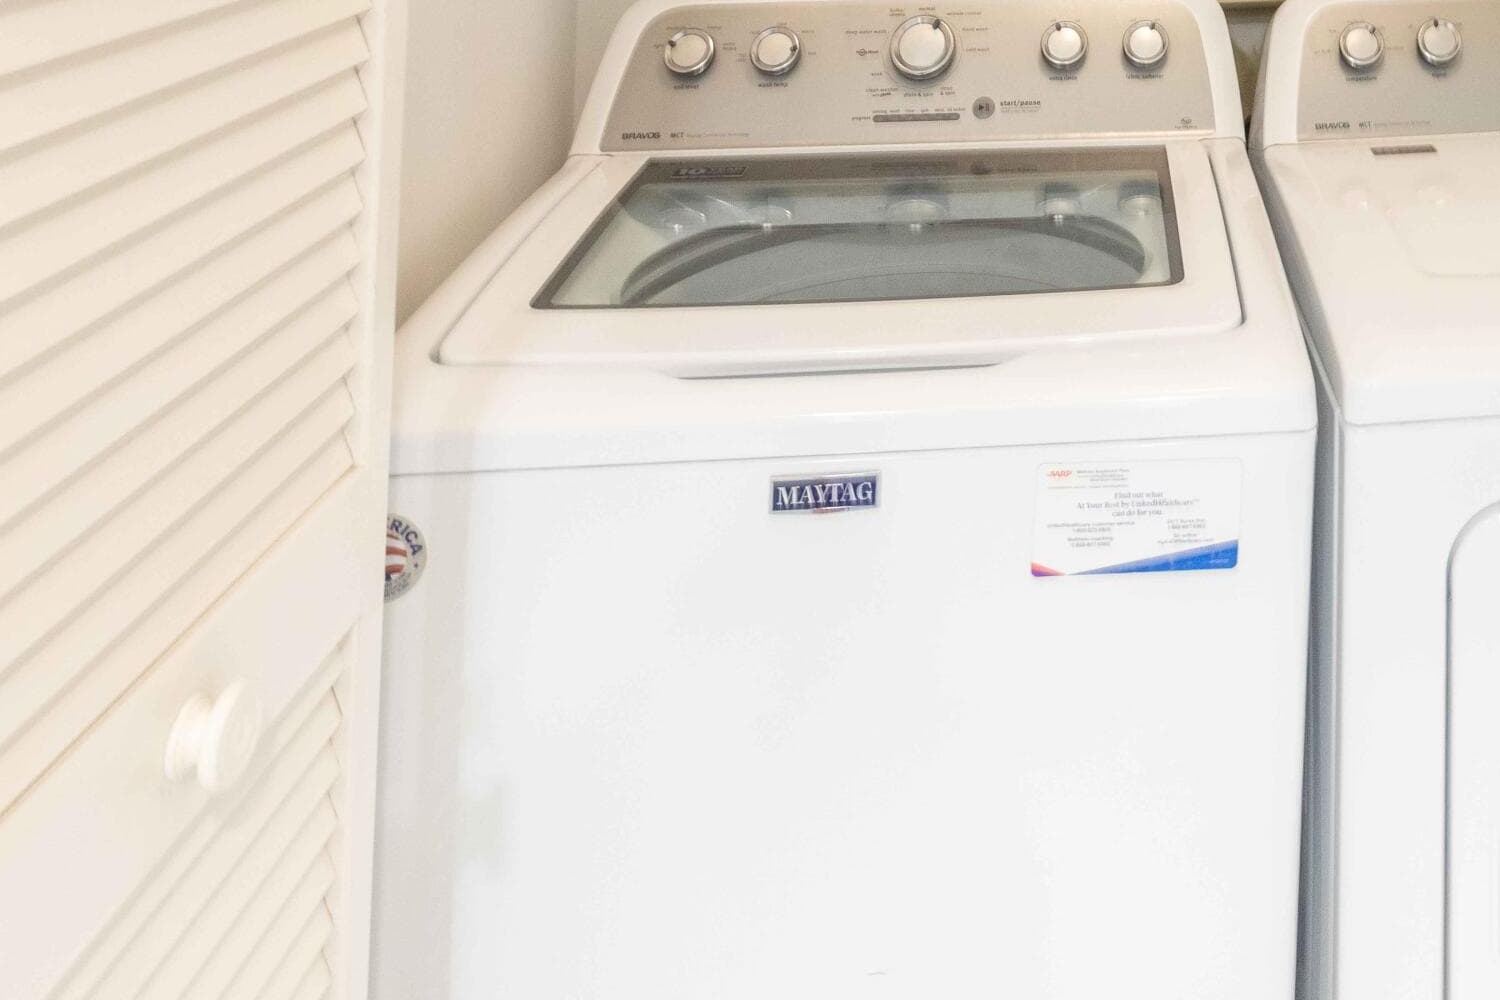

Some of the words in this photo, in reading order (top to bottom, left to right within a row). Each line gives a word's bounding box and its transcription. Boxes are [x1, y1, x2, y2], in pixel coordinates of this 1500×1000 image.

[1000, 99, 1041, 107] start/pause
[776, 481, 873, 506] MAYTAG
[386, 516, 424, 556] RICA
